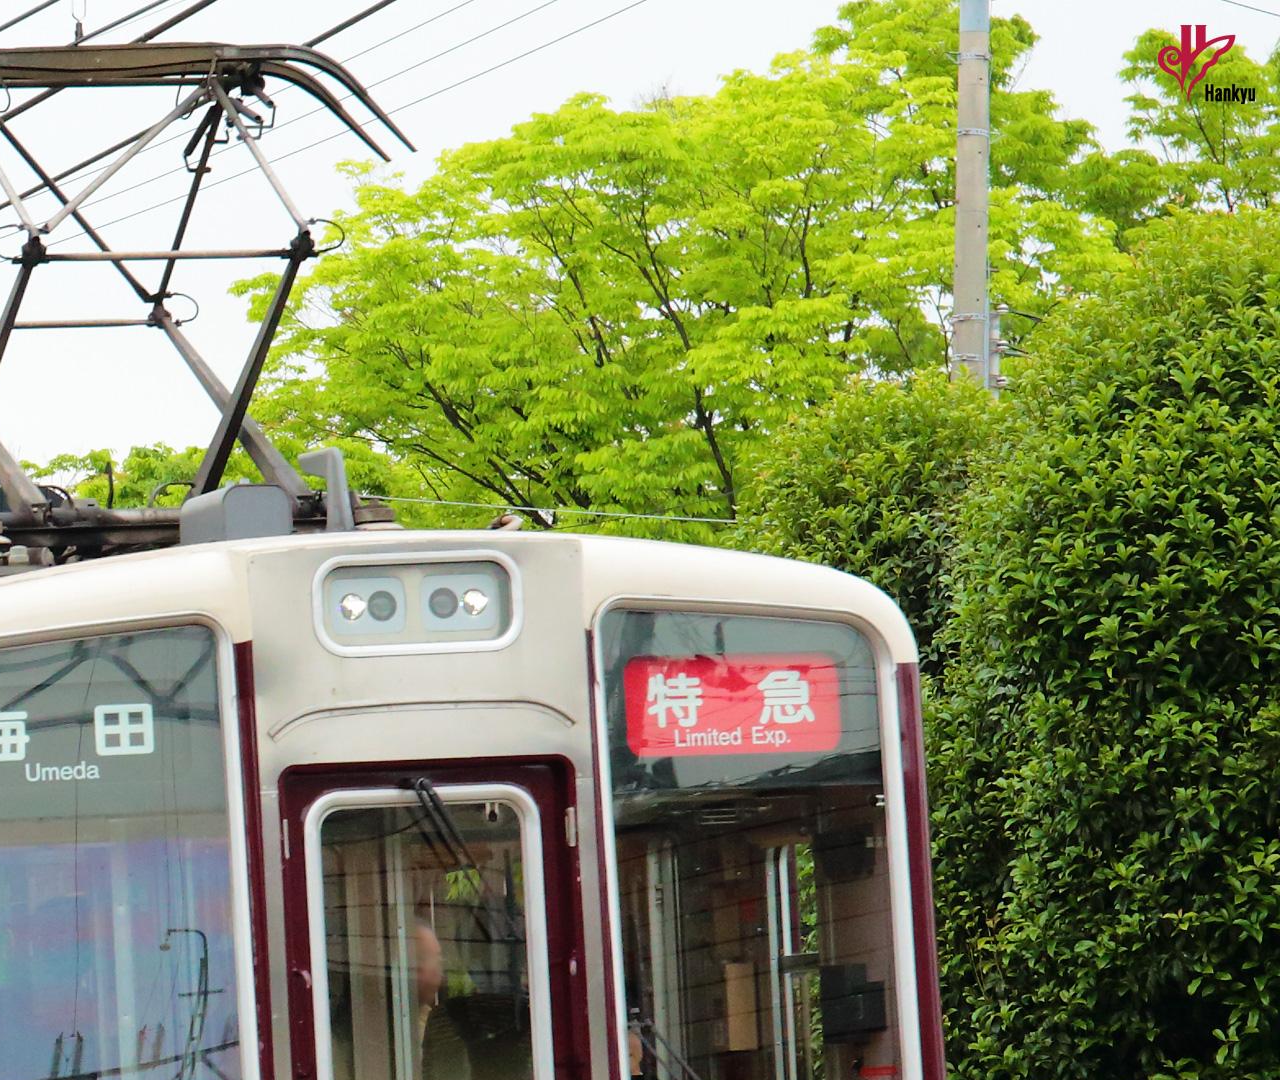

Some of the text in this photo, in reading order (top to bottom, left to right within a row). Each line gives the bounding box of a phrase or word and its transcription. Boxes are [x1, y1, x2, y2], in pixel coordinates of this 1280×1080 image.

[647, 670, 815, 728] 特急
[674, 726, 791, 747] Limited Exp.
[25, 762, 100, 782] Umeda
